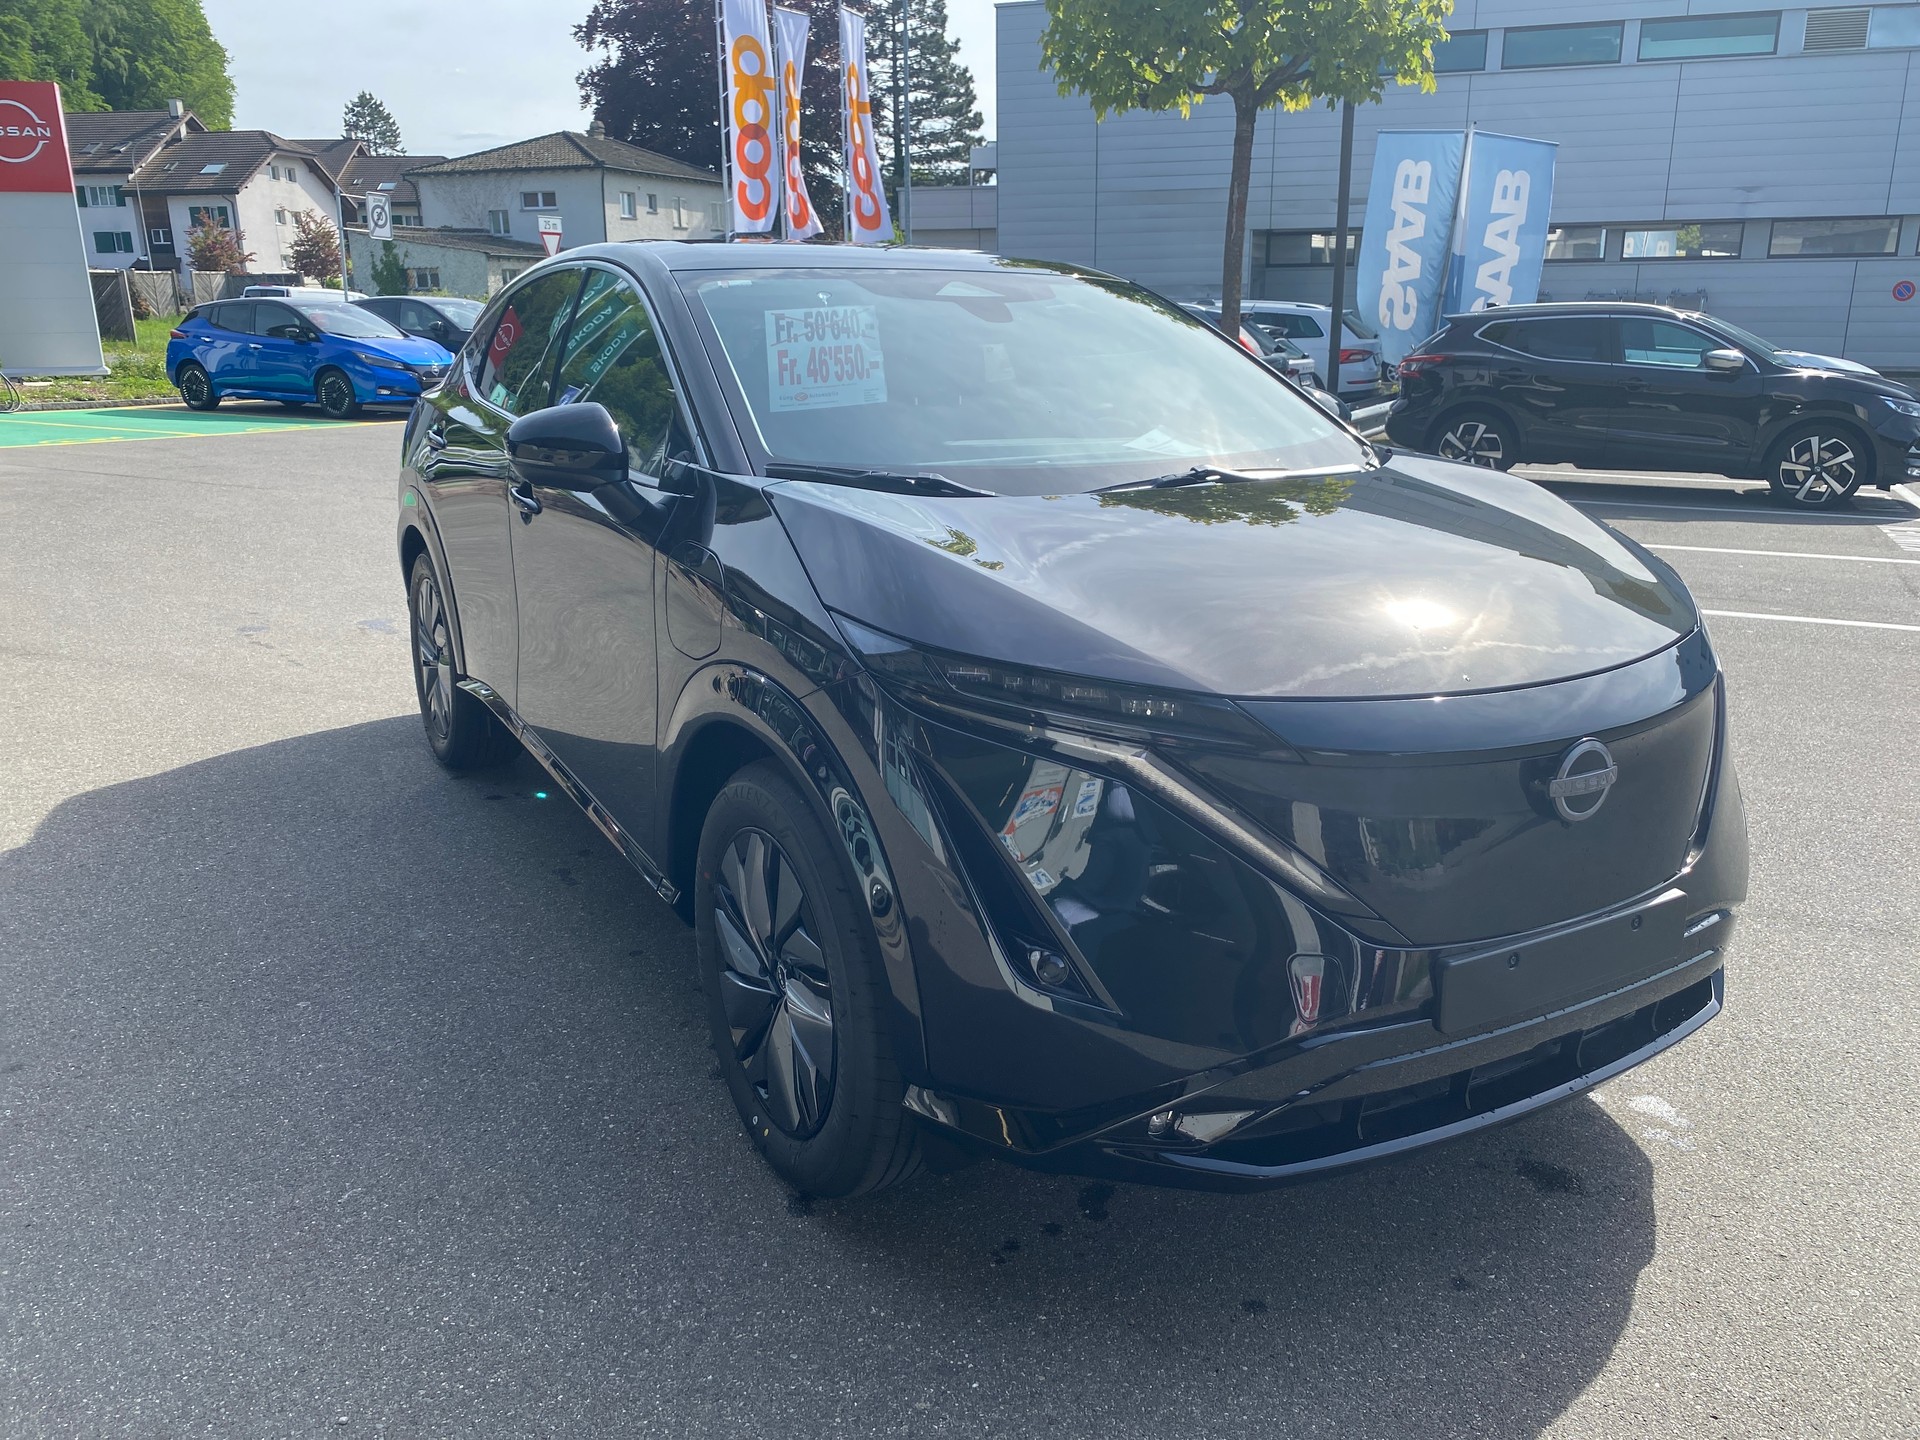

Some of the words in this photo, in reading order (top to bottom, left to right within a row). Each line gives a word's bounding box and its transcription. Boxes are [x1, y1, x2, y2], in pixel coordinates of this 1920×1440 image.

[732, 34, 776, 221] coop
[847, 62, 882, 231] coop
[774, 313, 799, 344] Fr.
[777, 349, 802, 386] Fr.
[807, 344, 880, 383] 46'550.-
[1553, 771, 1615, 795] NISSAN
